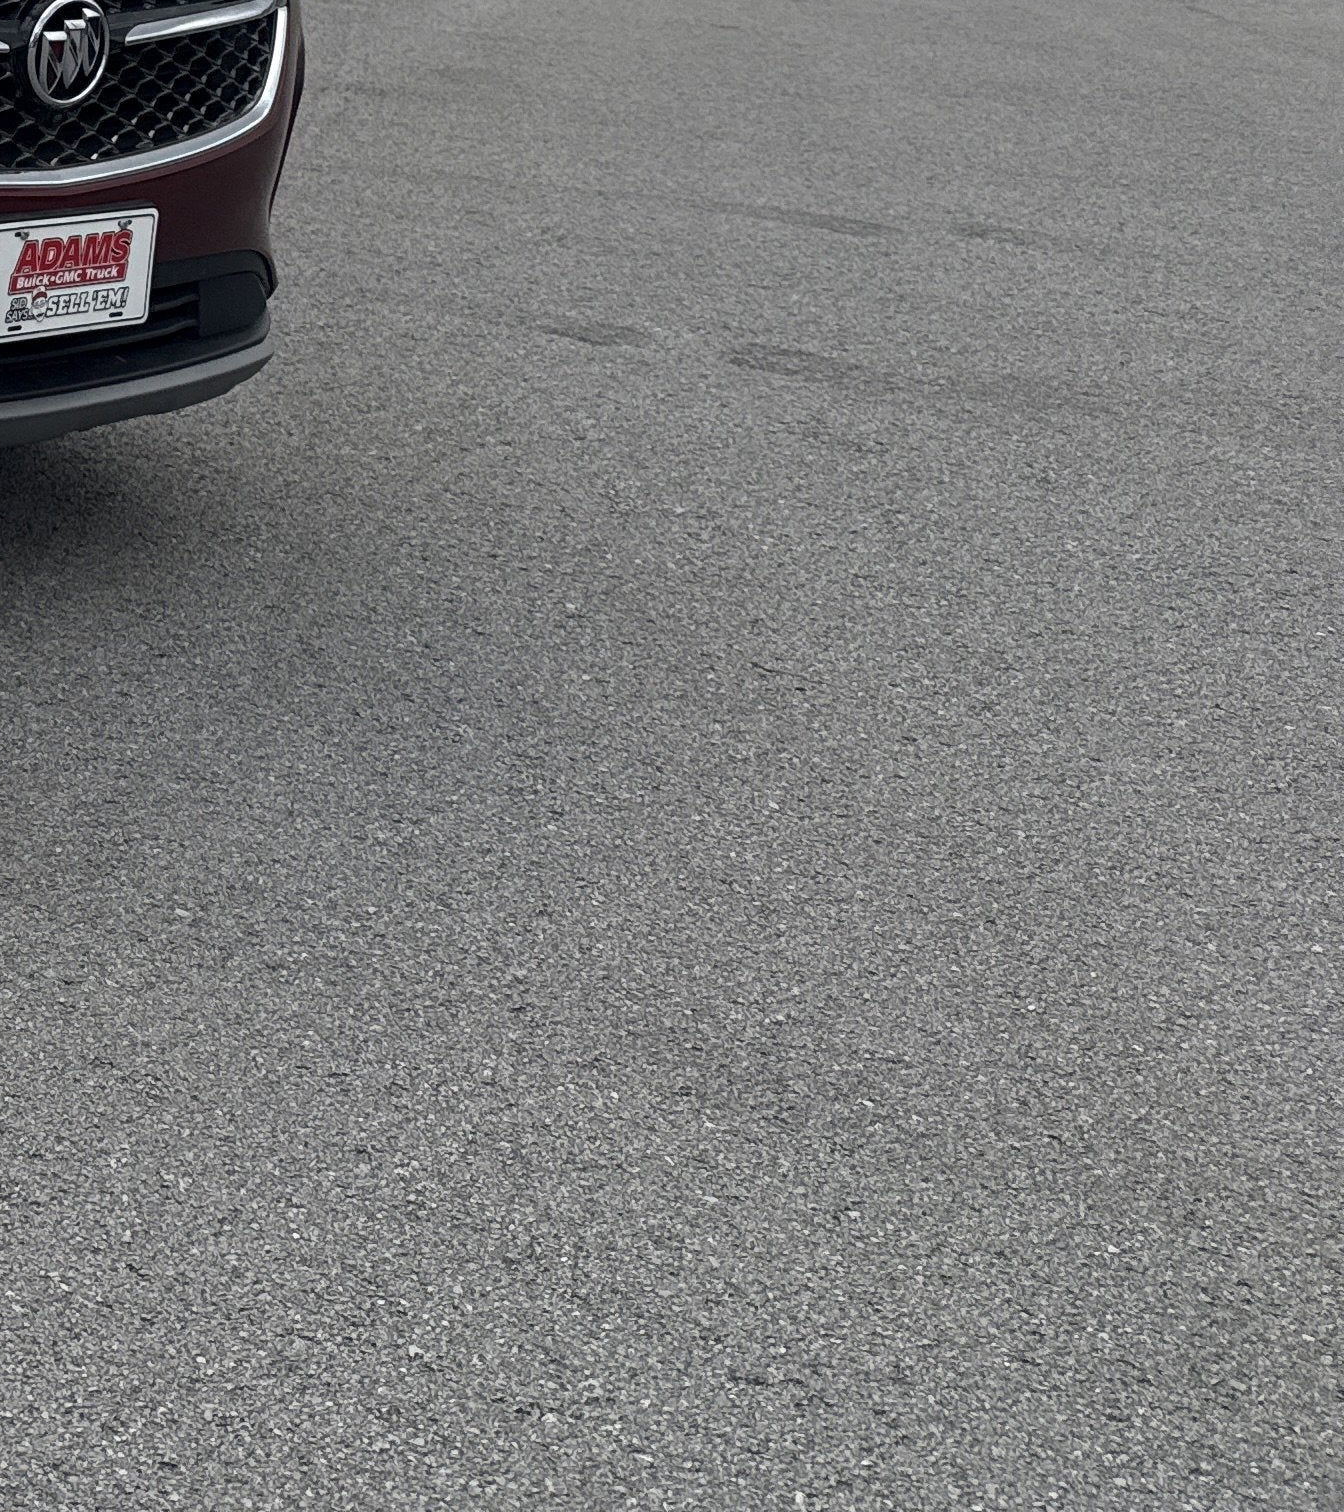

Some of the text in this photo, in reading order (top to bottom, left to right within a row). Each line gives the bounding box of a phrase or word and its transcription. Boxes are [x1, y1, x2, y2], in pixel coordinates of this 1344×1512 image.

[14, 229, 133, 275] ADAMS
[85, 265, 120, 280] Truck
[46, 291, 91, 318] SELL
